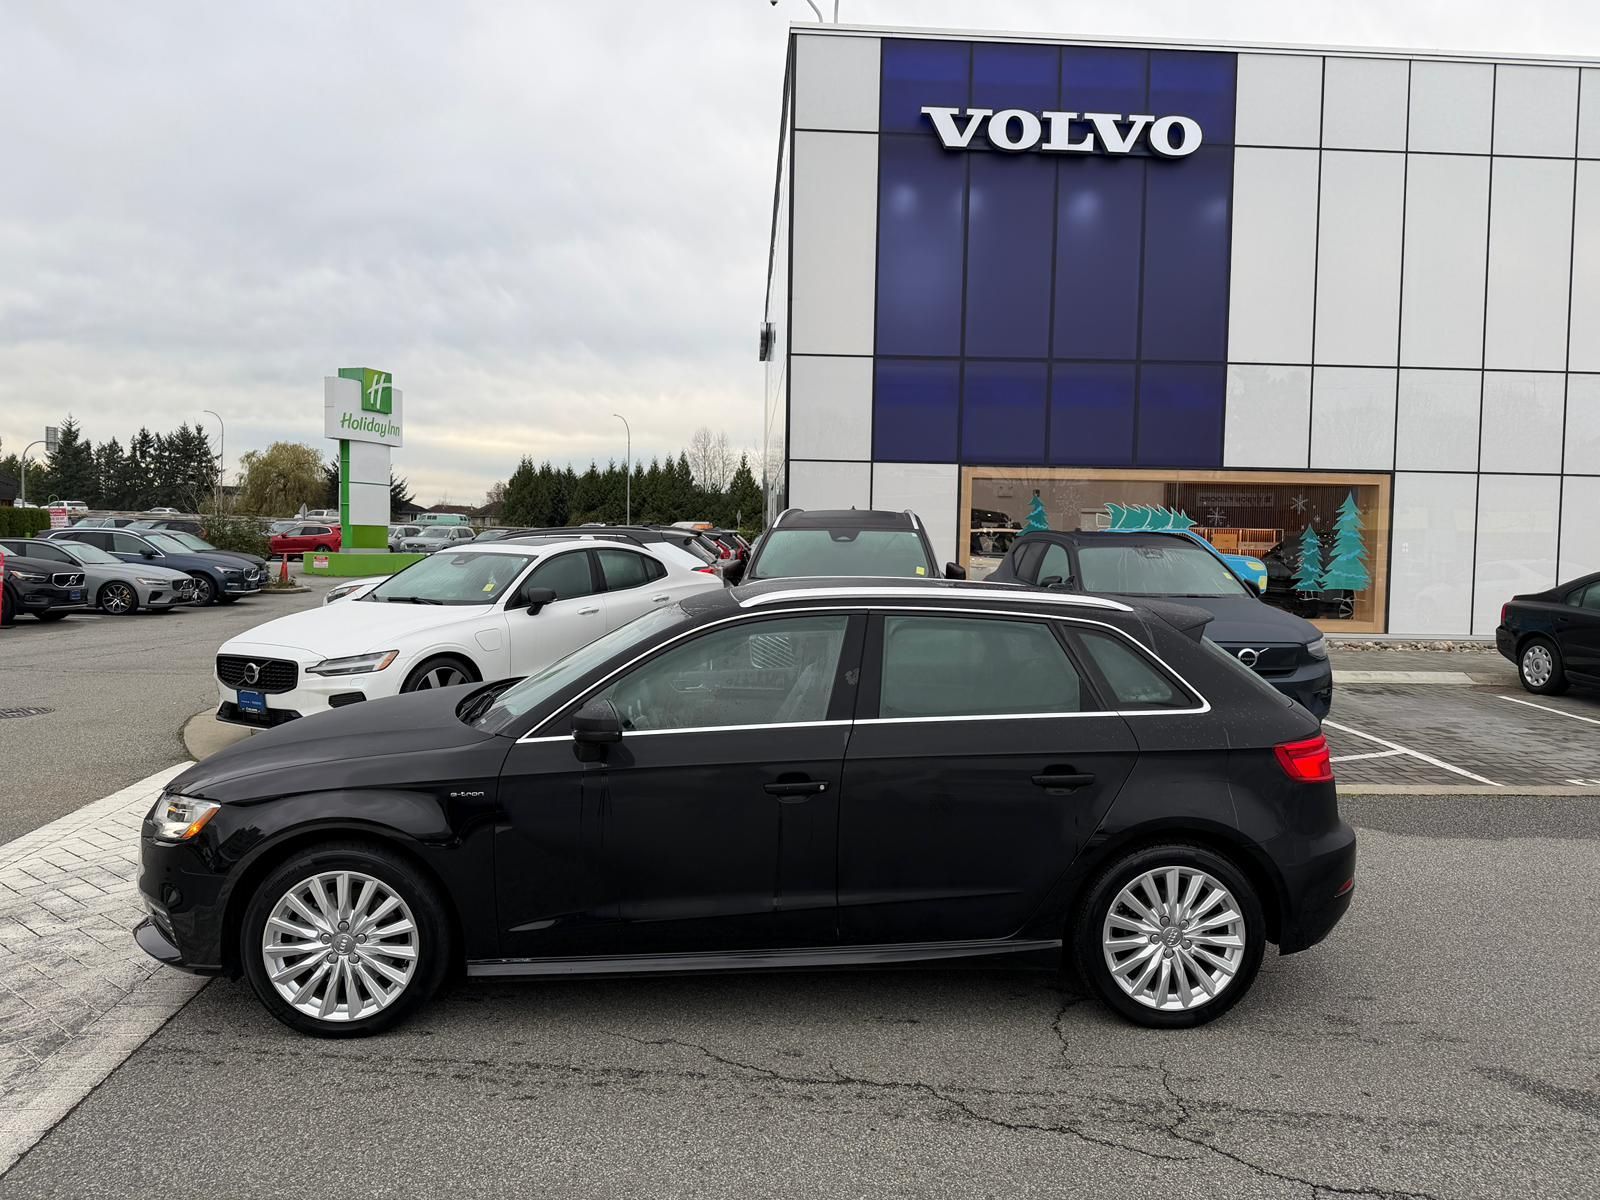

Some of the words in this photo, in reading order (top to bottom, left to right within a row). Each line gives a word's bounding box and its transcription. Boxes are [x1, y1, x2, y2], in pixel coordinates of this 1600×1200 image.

[920, 106, 1203, 156] VOLVO
[340, 412, 386, 437] Holiday
[388, 420, 399, 436] Inn
